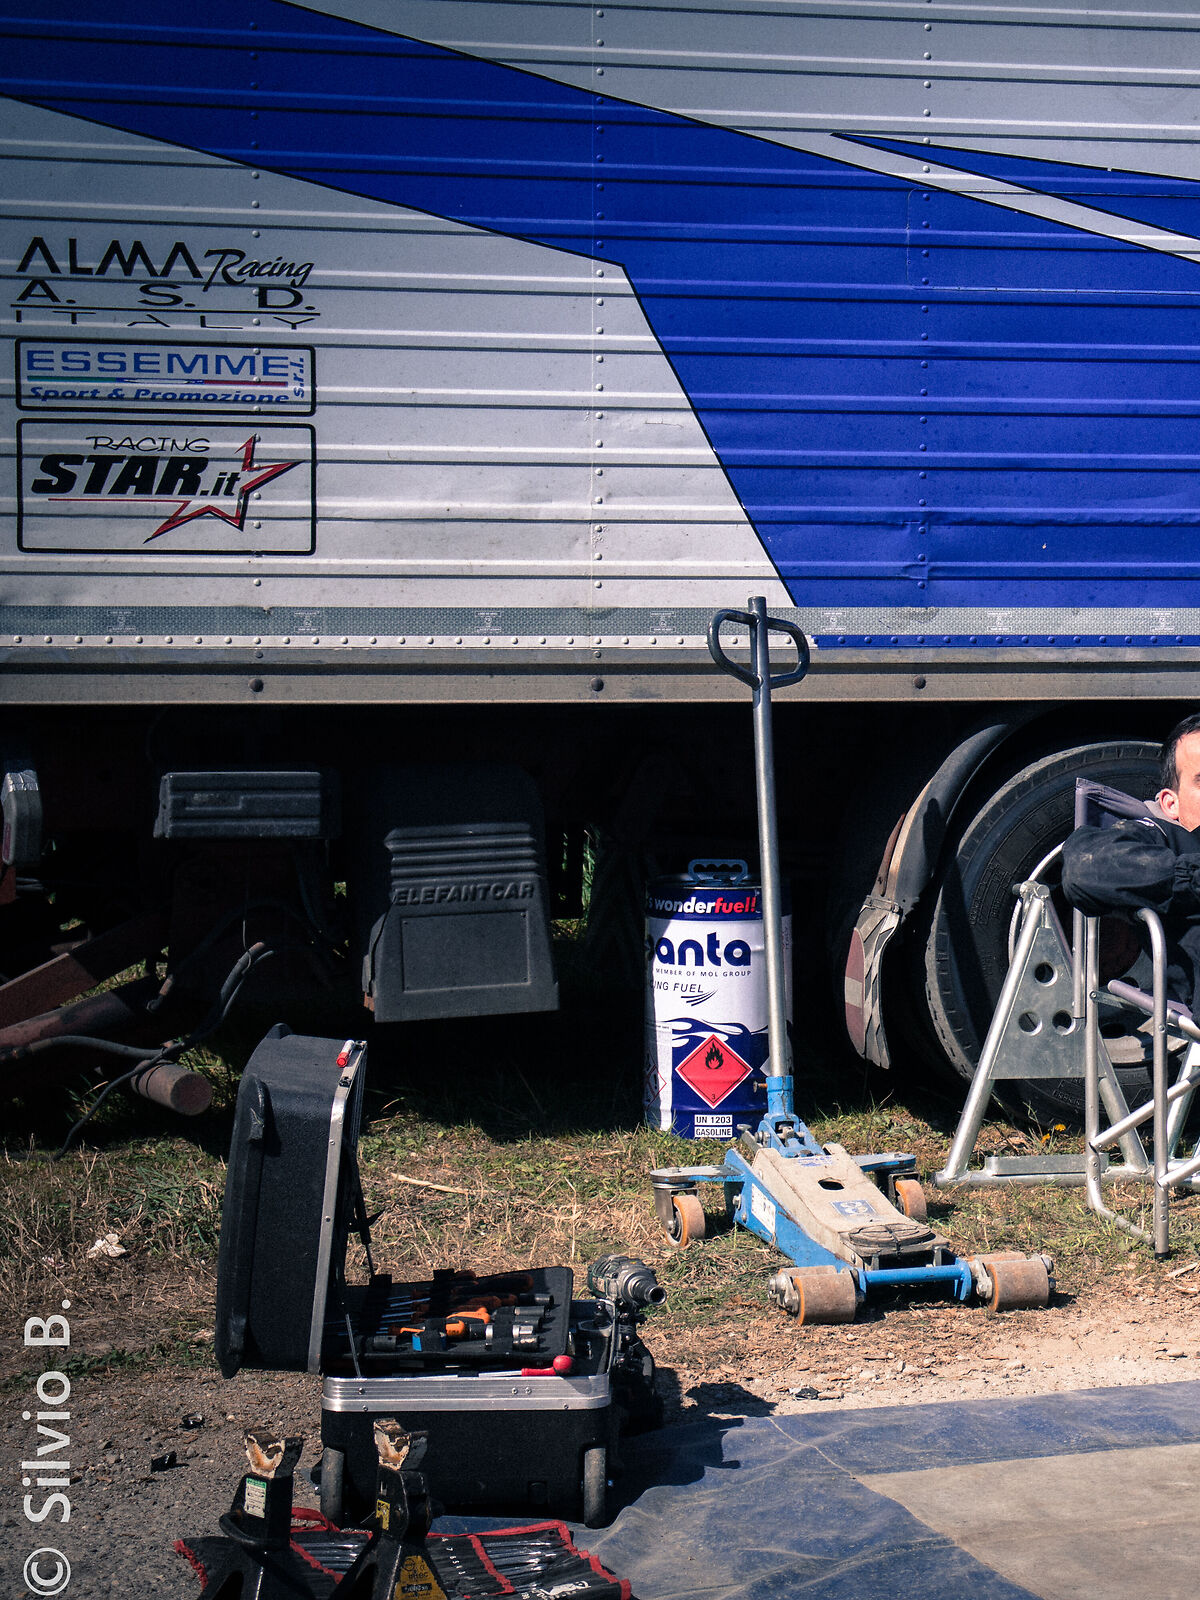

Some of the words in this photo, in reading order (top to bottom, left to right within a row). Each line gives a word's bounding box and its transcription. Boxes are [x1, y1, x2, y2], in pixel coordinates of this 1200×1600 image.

[16, 236, 204, 278] ALMA
[203, 248, 315, 292] Racing
[15, 309, 315, 330] ITALY
[26, 350, 289, 377] ESSEMME
[29, 386, 103, 402] Sport
[107, 388, 127, 400] &
[135, 388, 290, 403] Promozione
[86, 435, 210, 452] RACING
[393, 881, 536, 906] ELEFANTCAR
[654, 896, 757, 914] wonderfuel!
[656, 968, 682, 976] MEMBER
[673, 982, 704, 993] FUEL
[696, 1116, 707, 1124] UN
[711, 1116, 731, 1124] 1203
[695, 1128, 732, 1136] GASOLINE
